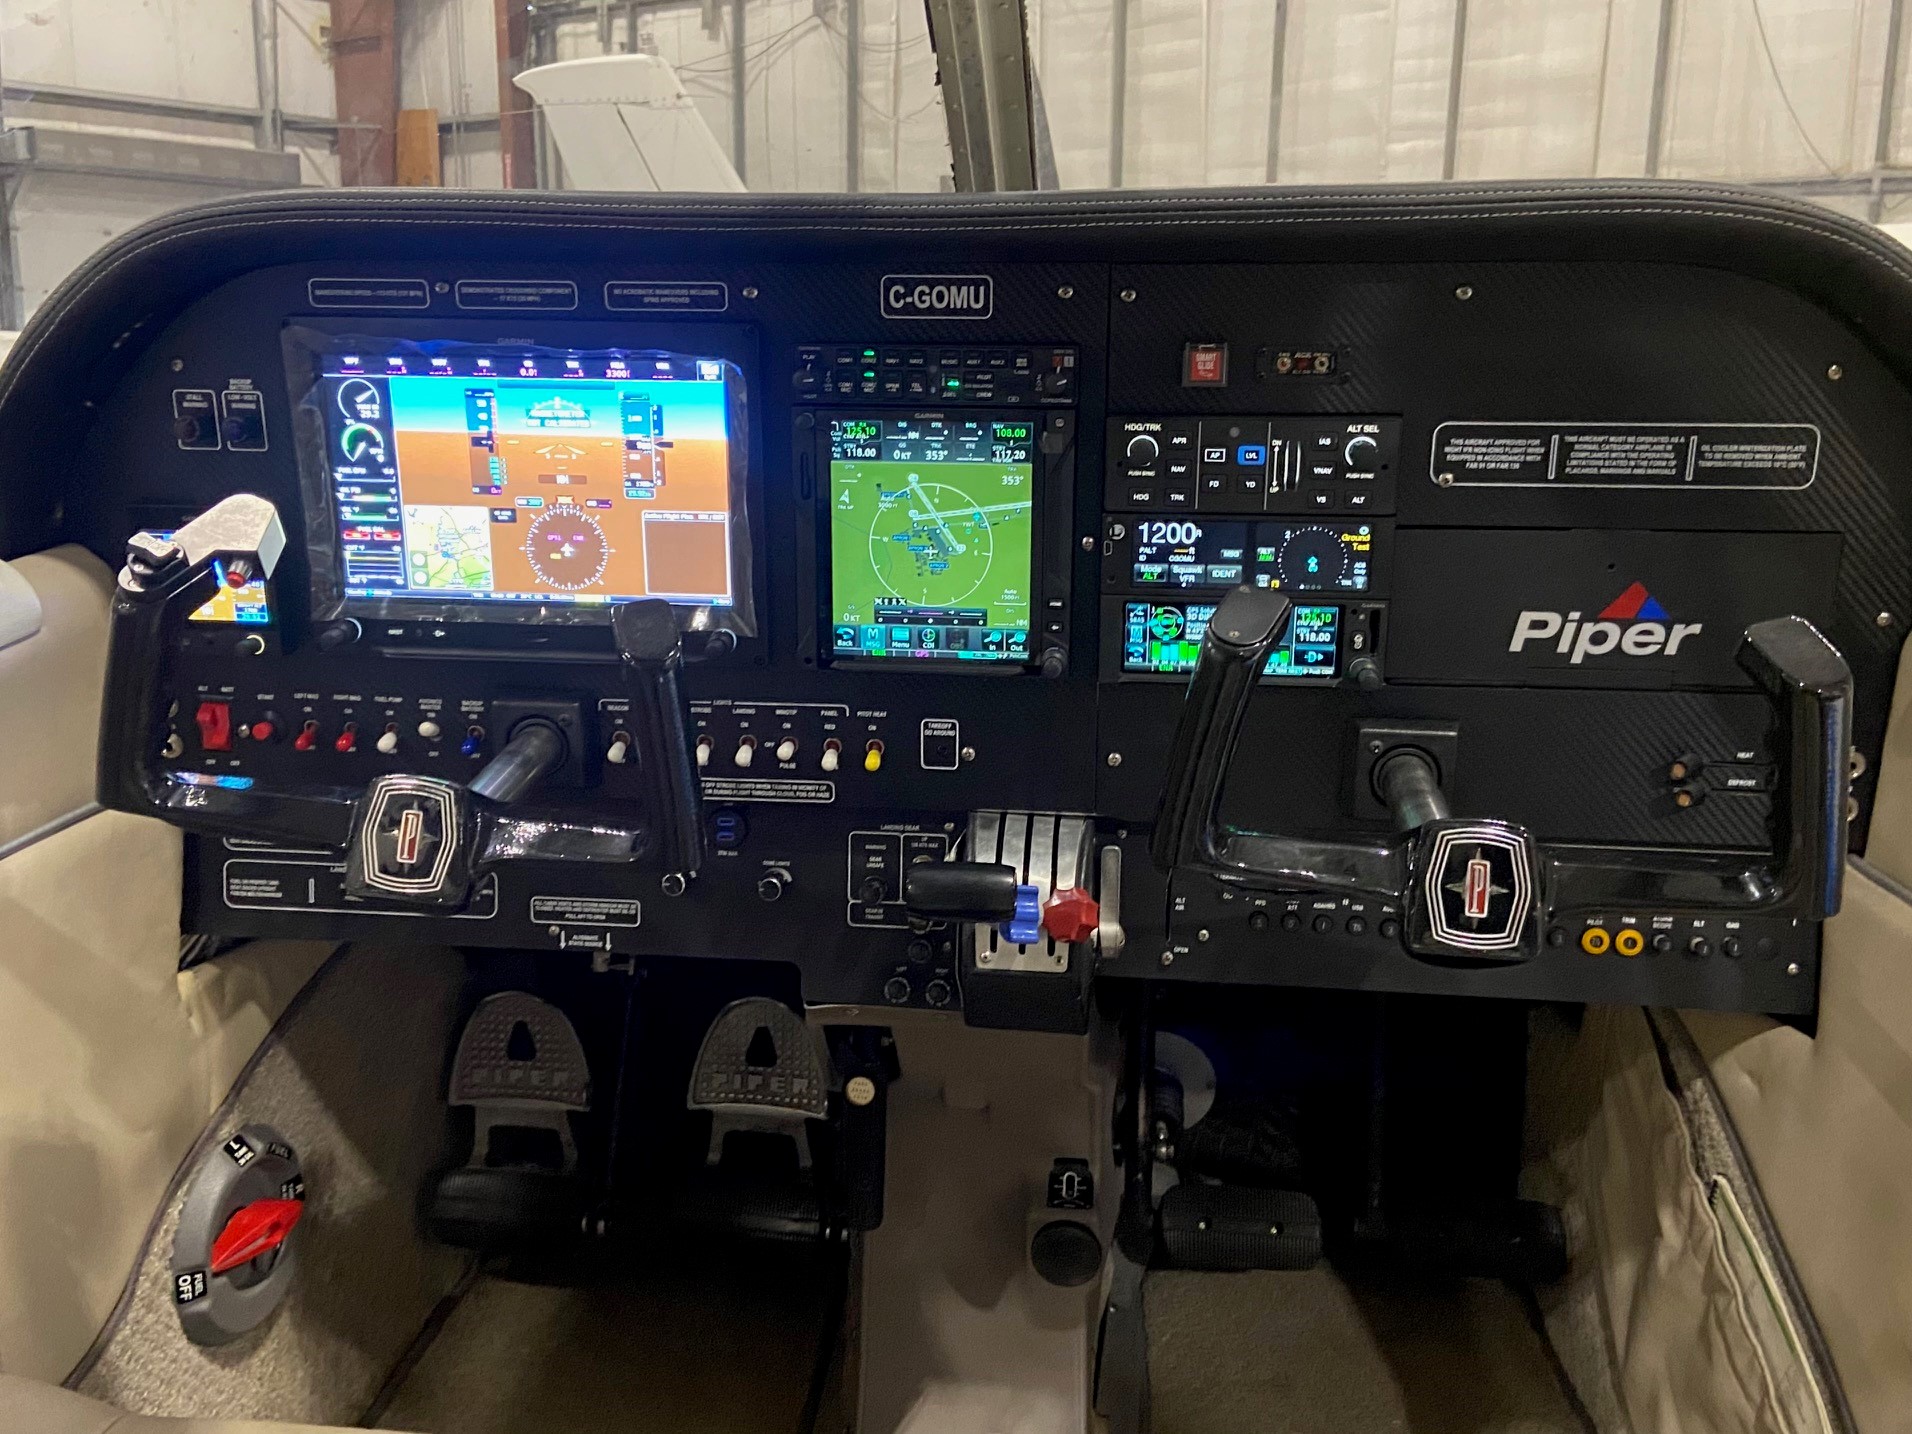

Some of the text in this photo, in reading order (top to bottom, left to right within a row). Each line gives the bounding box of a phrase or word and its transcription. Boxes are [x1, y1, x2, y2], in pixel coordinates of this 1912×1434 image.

[889, 285, 985, 309] C-GOMU
[1196, 353, 1216, 361] SMART
[1124, 423, 1162, 431] HDG/TRK
[1346, 425, 1380, 433] ALT SEL
[995, 428, 1026, 438] 108.00
[846, 448, 876, 458] 118.00
[926, 450, 948, 460] 353°
[995, 450, 1026, 460] 117.20
[1002, 475, 1024, 486] 353°
[1138, 522, 1196, 544] 1200
[1341, 534, 1370, 542] Ground
[1140, 565, 1162, 573] Mode
[1173, 566, 1202, 574] Squawk
[1212, 570, 1236, 578] IDENT
[1179, 574, 1196, 583] VFR
[1300, 632, 1331, 642] 118.00
[1508, 610, 1702, 664] Piper
[1470, 865, 1484, 912] P
[712, 1073, 809, 1094] PIPER
[178, 1274, 192, 1301] OFF
[194, 1272, 204, 1297] FUEL
